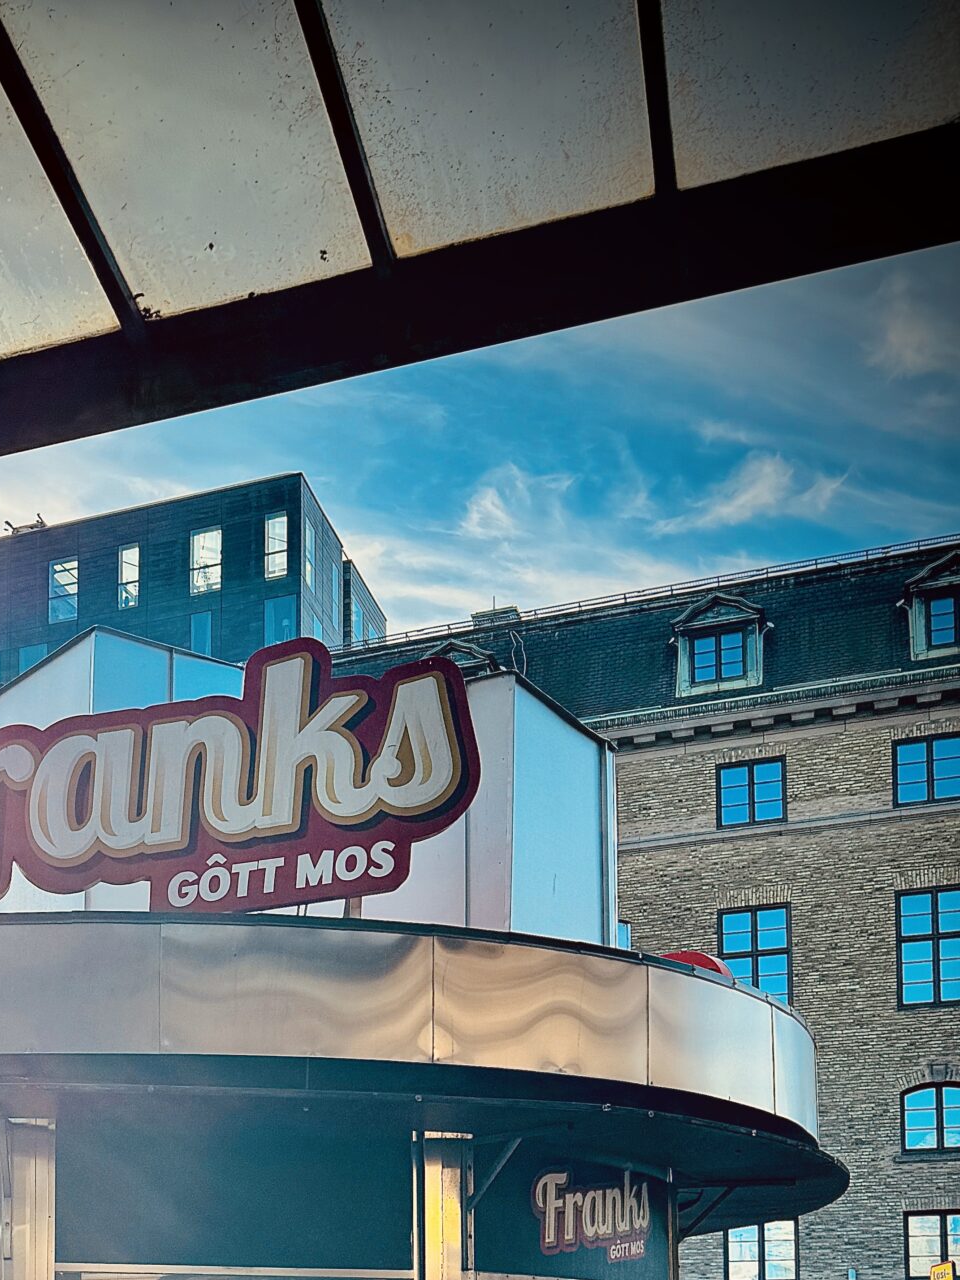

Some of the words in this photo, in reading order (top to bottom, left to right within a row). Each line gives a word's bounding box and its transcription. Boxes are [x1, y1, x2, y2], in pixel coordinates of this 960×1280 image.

[295, 840, 396, 889] MOS
[536, 1170, 650, 1243] Franks
[631, 1240, 645, 1256] MOS
